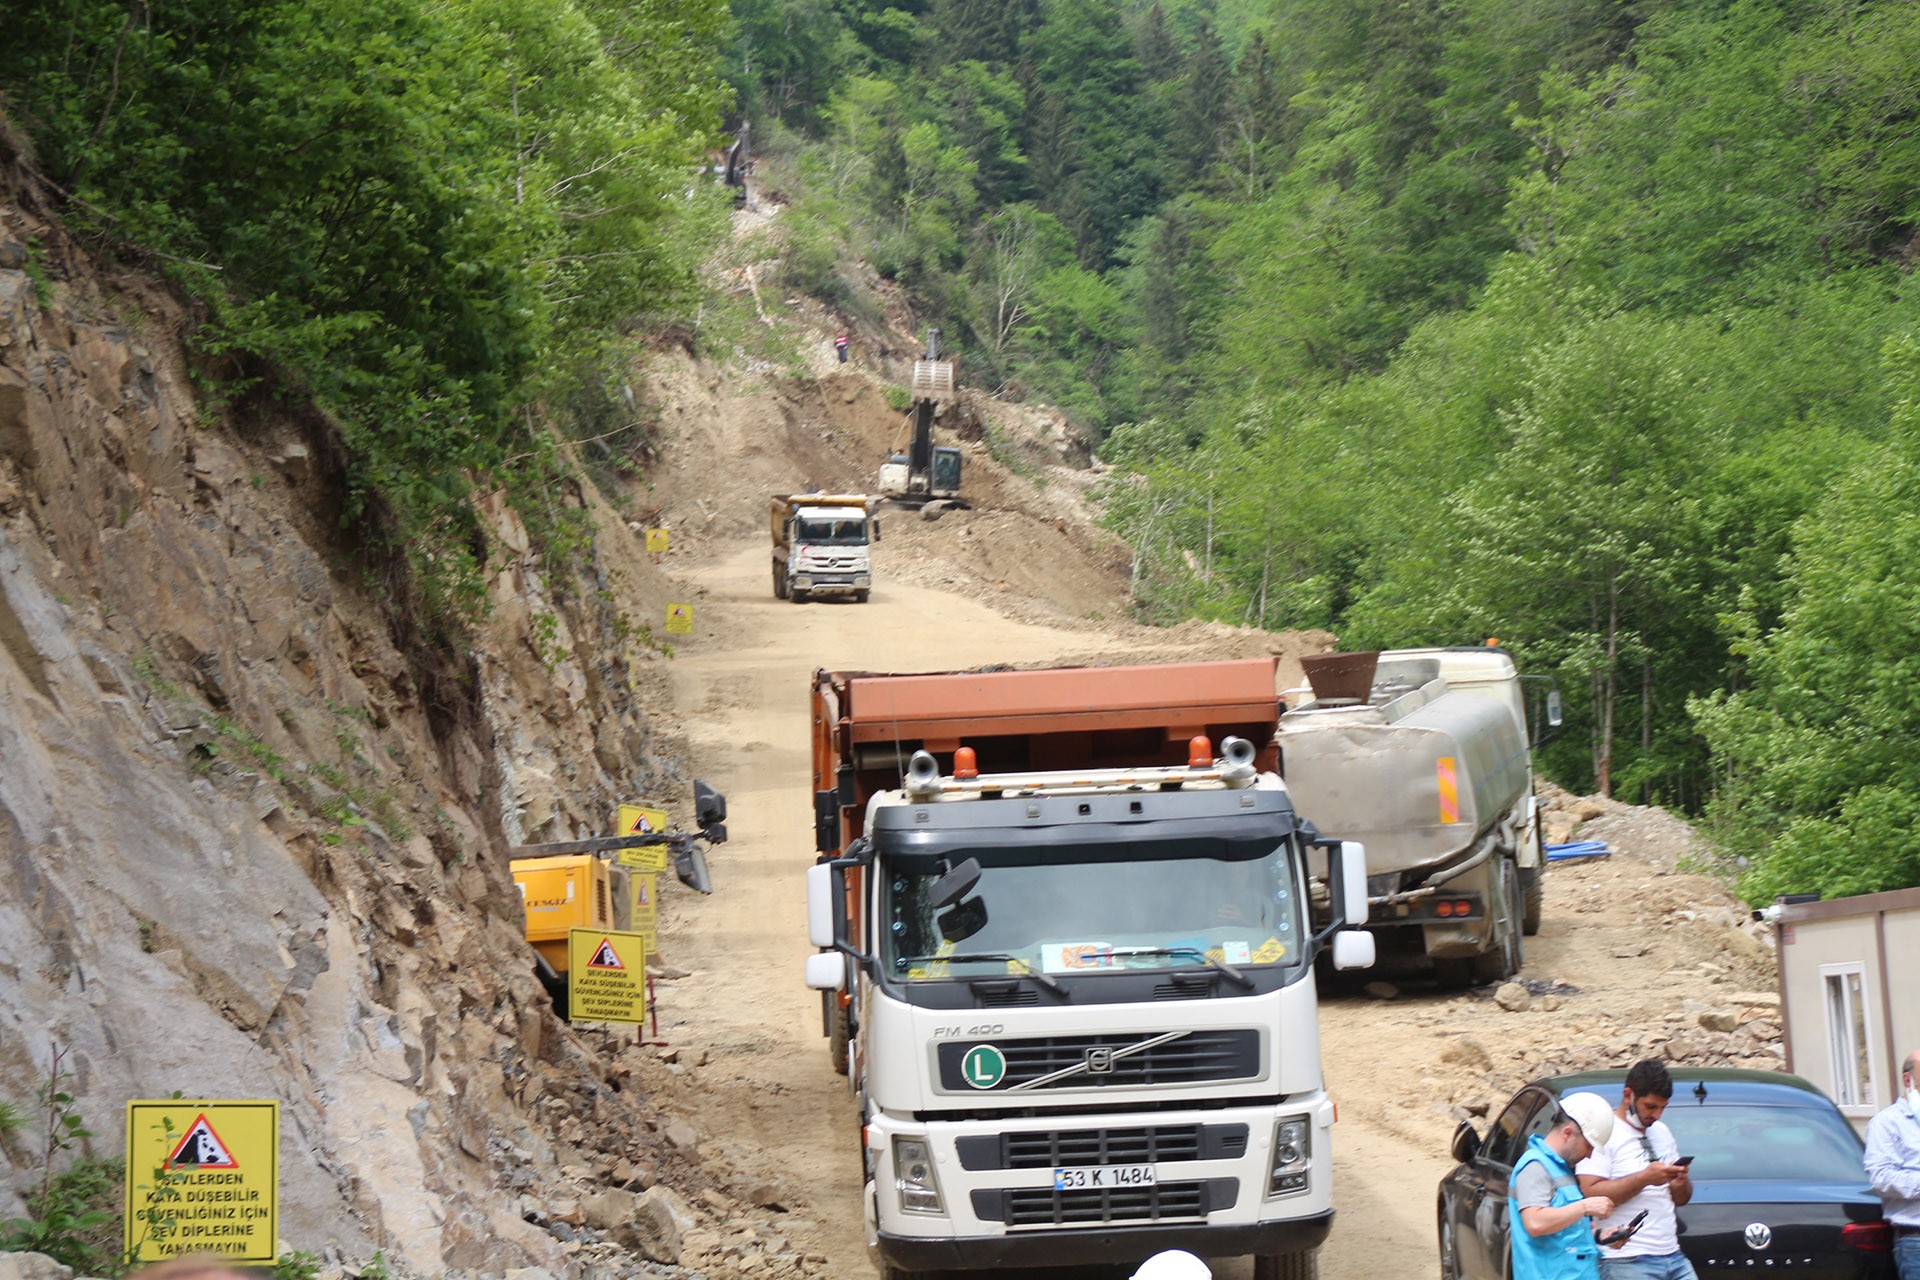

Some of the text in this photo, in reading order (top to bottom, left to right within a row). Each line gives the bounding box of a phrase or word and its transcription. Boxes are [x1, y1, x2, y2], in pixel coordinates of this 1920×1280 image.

[934, 1024, 1004, 1038] FM 400
[974, 1053, 994, 1081] L
[1065, 1167, 1153, 1187] 53 K 1484
[187, 1187, 260, 1205] DÜŞEBİLİR
[240, 1204, 269, 1221] İÇİN
[182, 1221, 255, 1237] DİPLERİNE
